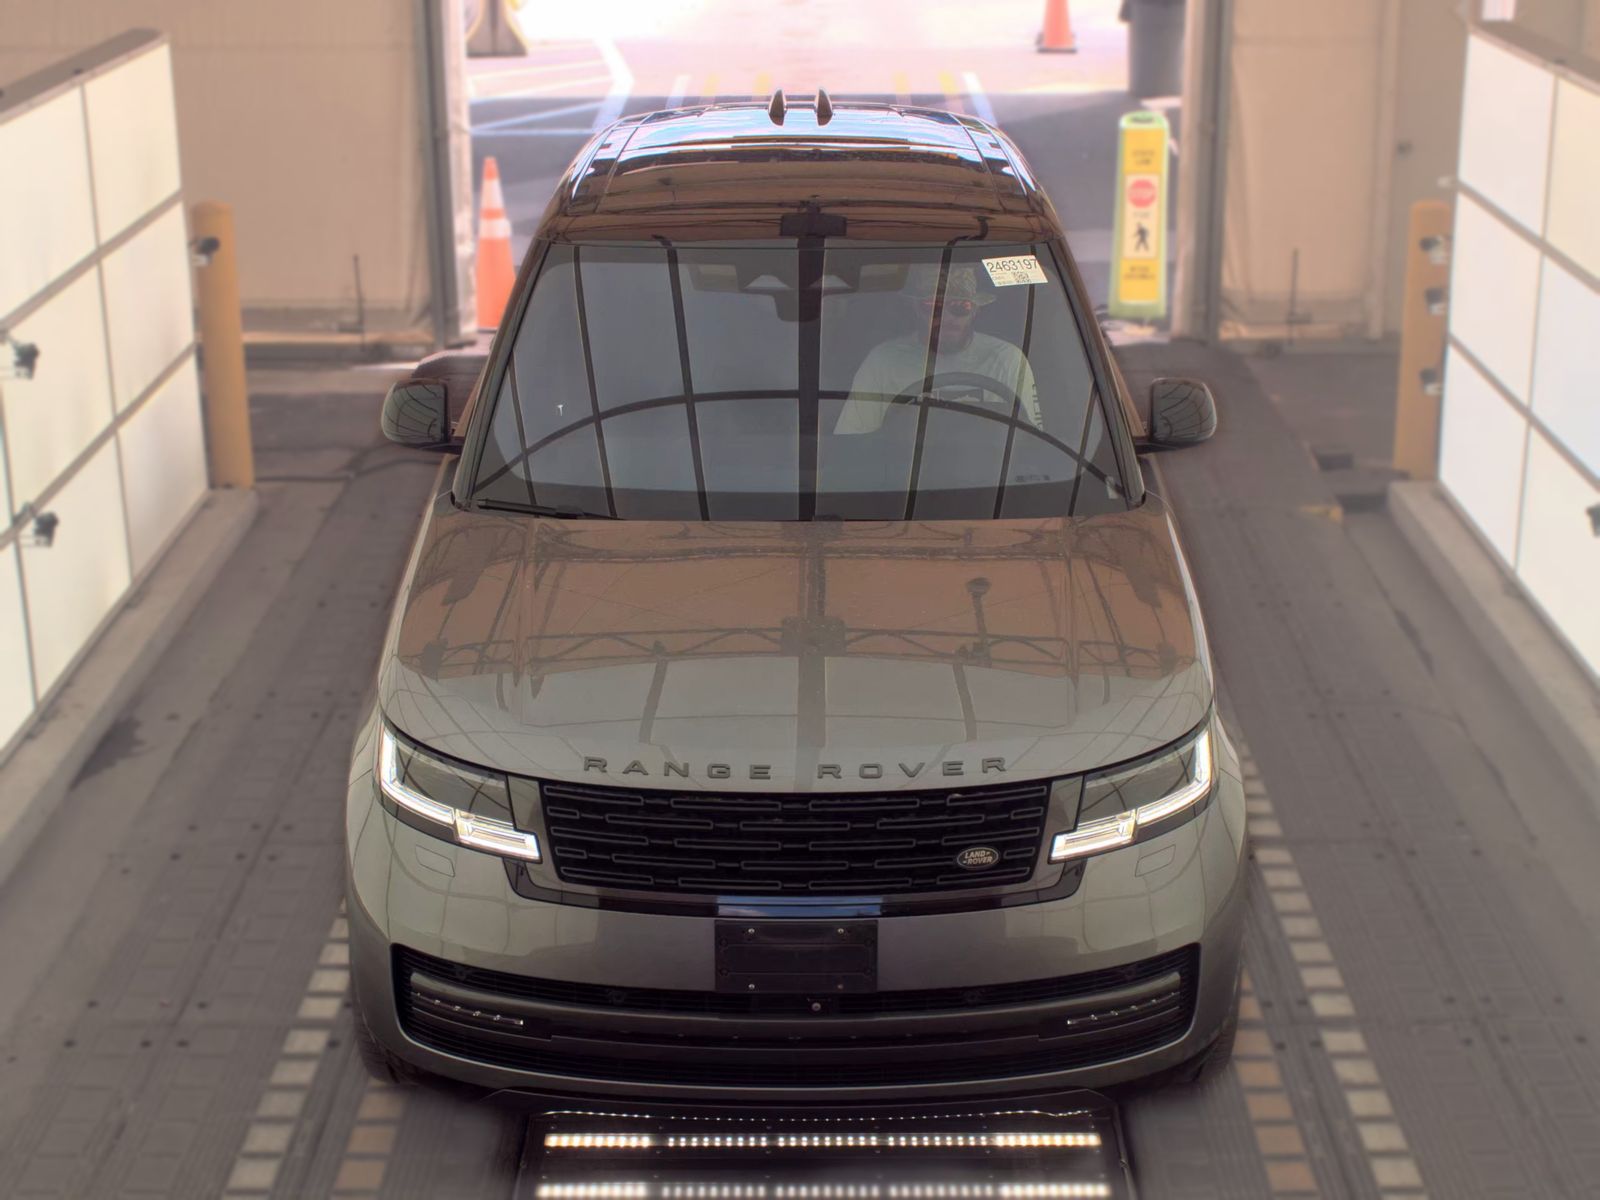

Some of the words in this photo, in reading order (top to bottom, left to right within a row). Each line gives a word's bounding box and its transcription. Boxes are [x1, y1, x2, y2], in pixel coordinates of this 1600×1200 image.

[986, 258, 1038, 273] 2463197
[584, 756, 771, 780] RANGE
[817, 757, 1006, 779] ROVER
